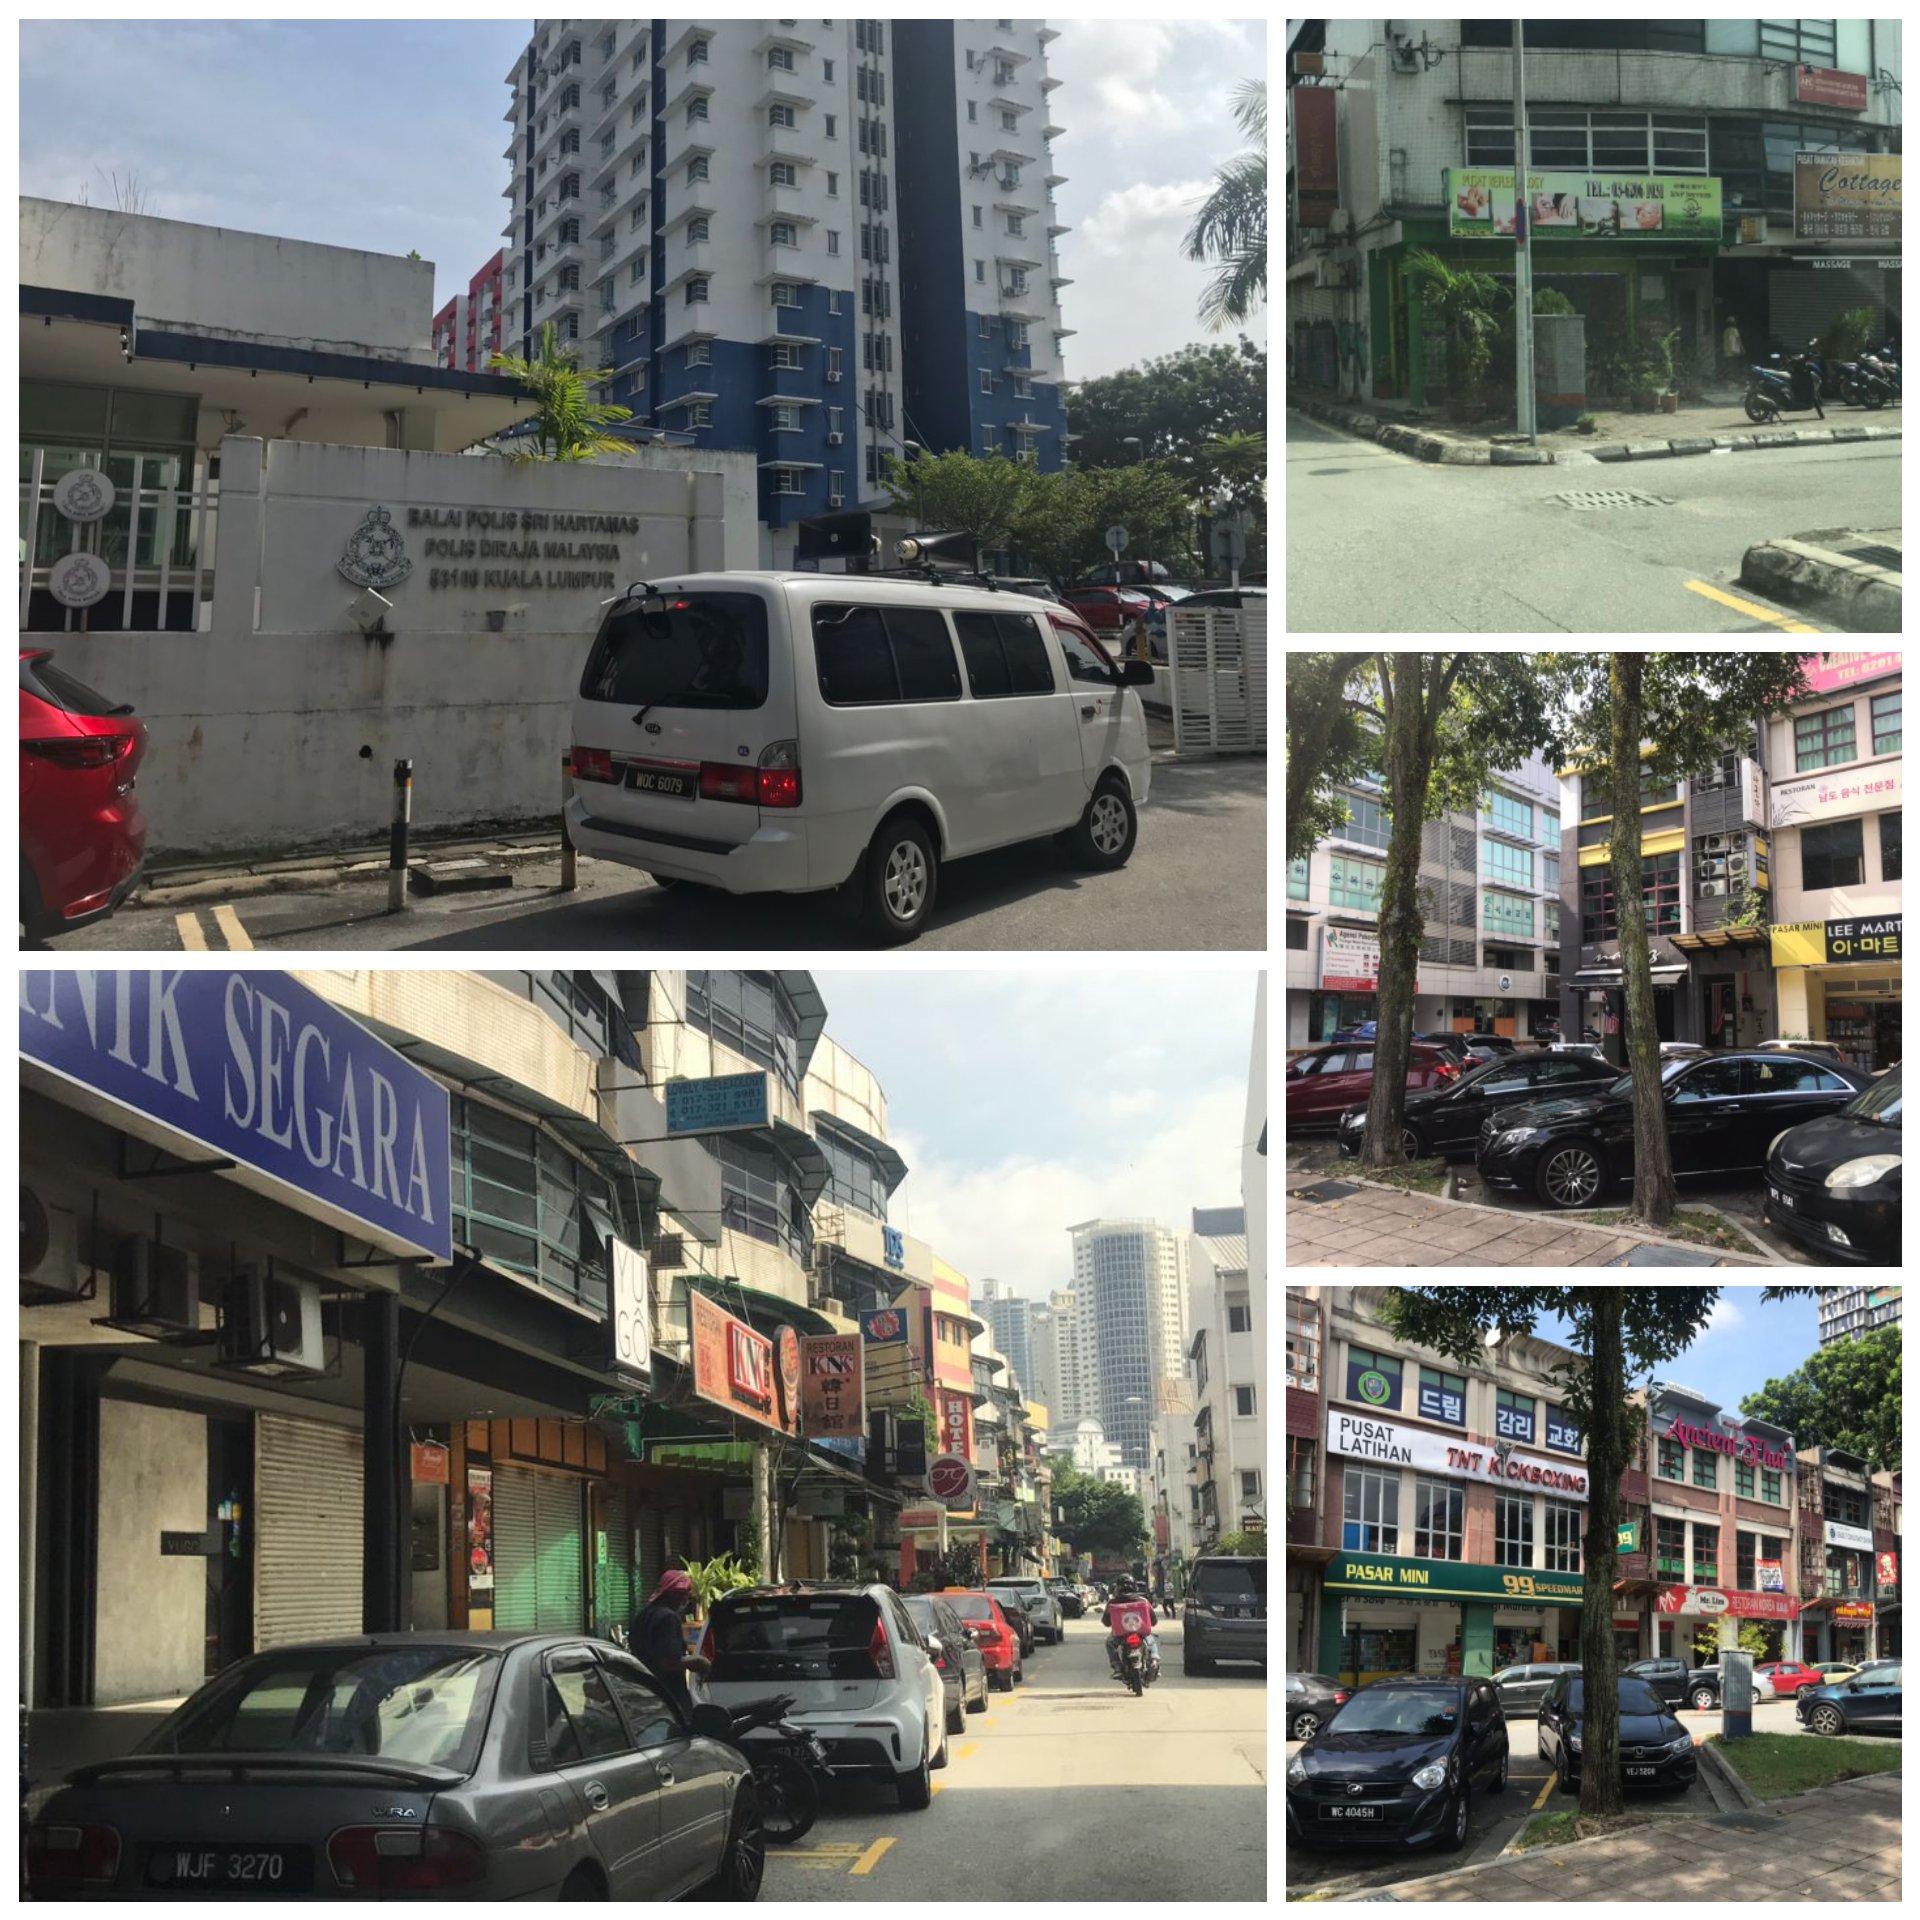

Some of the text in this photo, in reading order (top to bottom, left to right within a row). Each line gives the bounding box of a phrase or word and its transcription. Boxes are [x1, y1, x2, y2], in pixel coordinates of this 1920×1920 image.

[1819, 167, 1902, 196] Cottage
[1813, 261, 1851, 269] MASSAGE
[408, 508, 640, 534] BALAI POLIS SRI HARTAMAS
[425, 538, 620, 561] POLIS DIRAJA MALAYSIA
[484, 569, 543, 588] KUALA
[546, 570, 616, 590] LUMPUR
[658, 776, 684, 793] 6079
[1780, 784, 1816, 796] RESTORAN
[1773, 923, 1823, 934] PASAR MINI
[1828, 920, 1902, 937] LEE MART
[224, 972, 435, 1225] SEGARA
[667, 1081, 699, 1096] LOVELY
[806, 1341, 854, 1353] RESTORAN
[808, 1354, 854, 1375] KNK
[948, 1400, 964, 1455] HOTE
[1340, 1417, 1395, 1442] PUSAT
[1420, 1388, 1581, 1452] 드림 감리 교회
[1340, 1434, 1412, 1464] LATIHAN
[1664, 1411, 1788, 1471] Ancient Thai
[1447, 1447, 1587, 1493] TNT KCKBOXING
[1346, 1564, 1429, 1584] PASAR MINI
[1503, 1574, 1584, 1597] 99 SPEEDMAR
[1732, 1596, 1759, 1610] RESTORAN
[372, 1806, 416, 1818] WIRA
[1331, 1807, 1374, 1818] WC 4045H
[176, 1853, 283, 1880] WJF 3270
